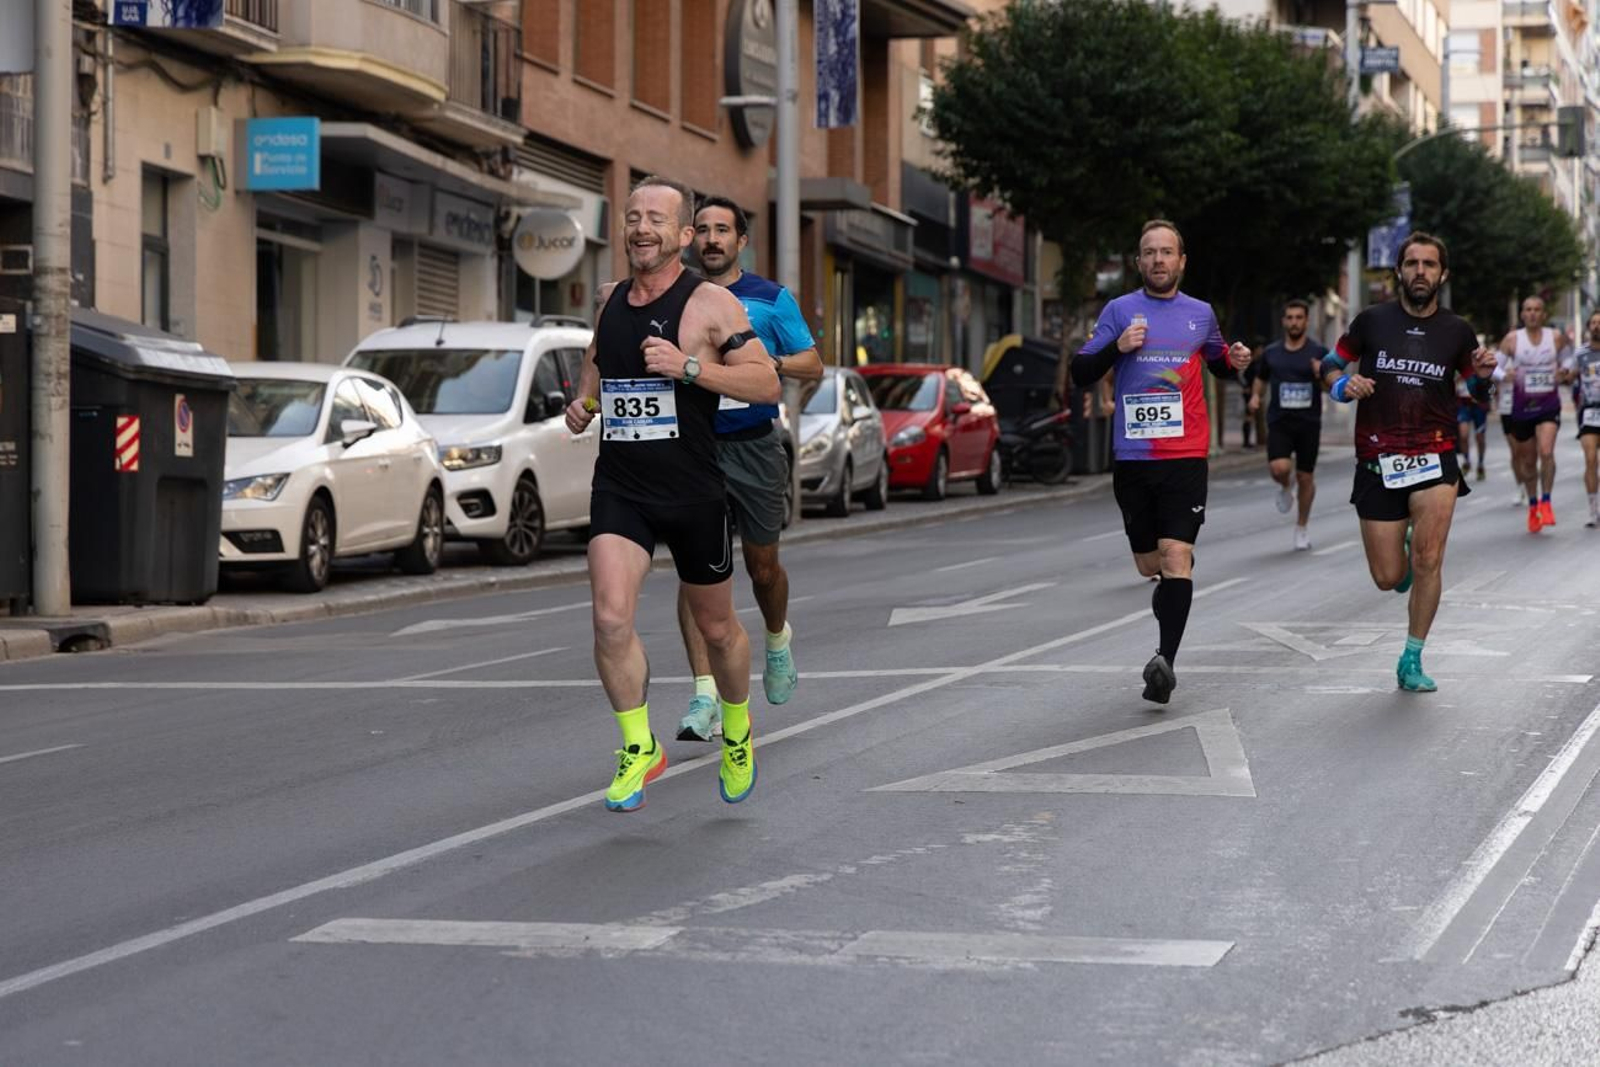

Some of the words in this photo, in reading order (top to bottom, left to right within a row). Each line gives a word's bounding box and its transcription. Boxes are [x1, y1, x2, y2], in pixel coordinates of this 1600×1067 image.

[254, 132, 308, 146] endesa
[1376, 357, 1446, 377] BASTITAN
[1396, 377, 1424, 386] TRAIL
[613, 397, 660, 417] 835
[1135, 406, 1172, 422] 695
[1393, 454, 1429, 472] 626
